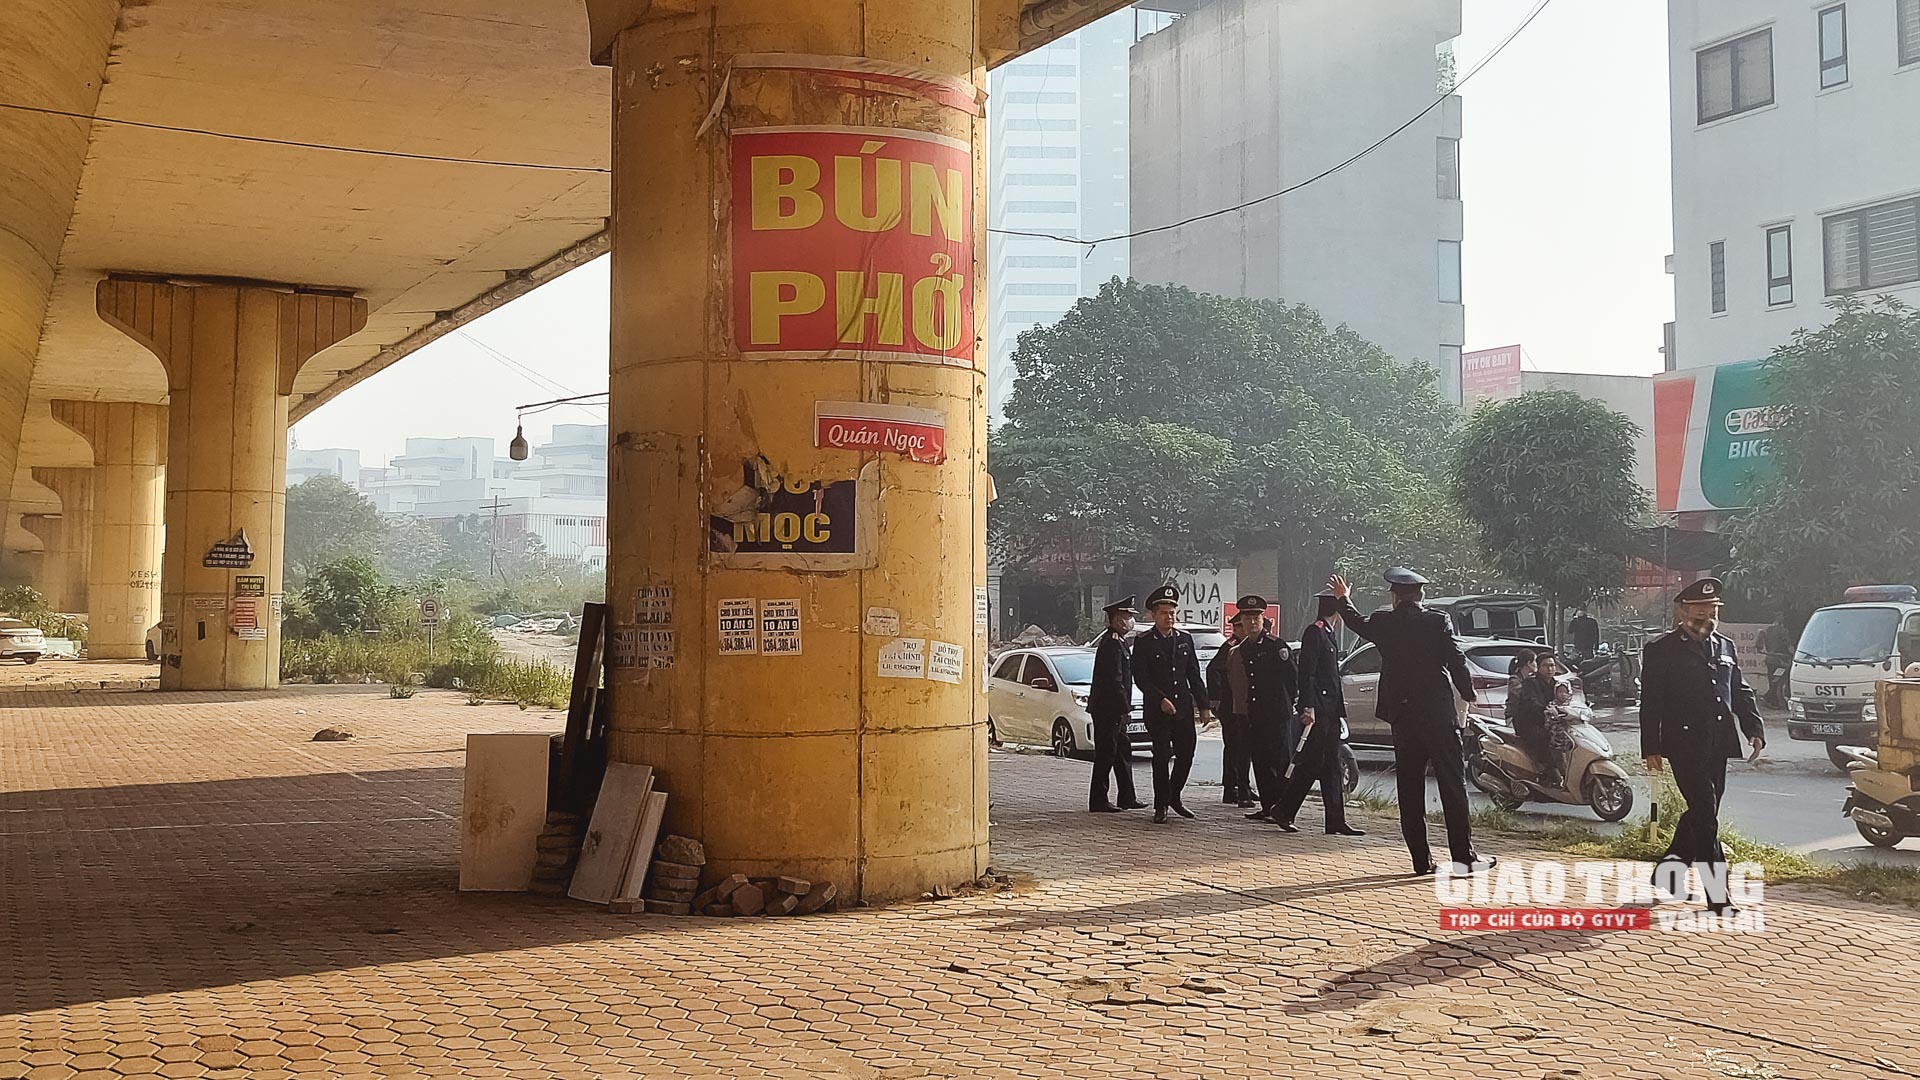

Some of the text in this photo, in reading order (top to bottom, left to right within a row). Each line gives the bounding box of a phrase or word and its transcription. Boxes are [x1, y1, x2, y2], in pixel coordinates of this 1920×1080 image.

[751, 140, 963, 244] BÚN
[750, 252, 964, 351] PHỞ
[828, 424, 879, 448] Quán
[721, 620, 732, 630] 10
[747, 619, 753, 629] 9
[764, 621, 775, 631] 10
[791, 620, 798, 630] 9
[1814, 685, 1847, 697] CSTT
